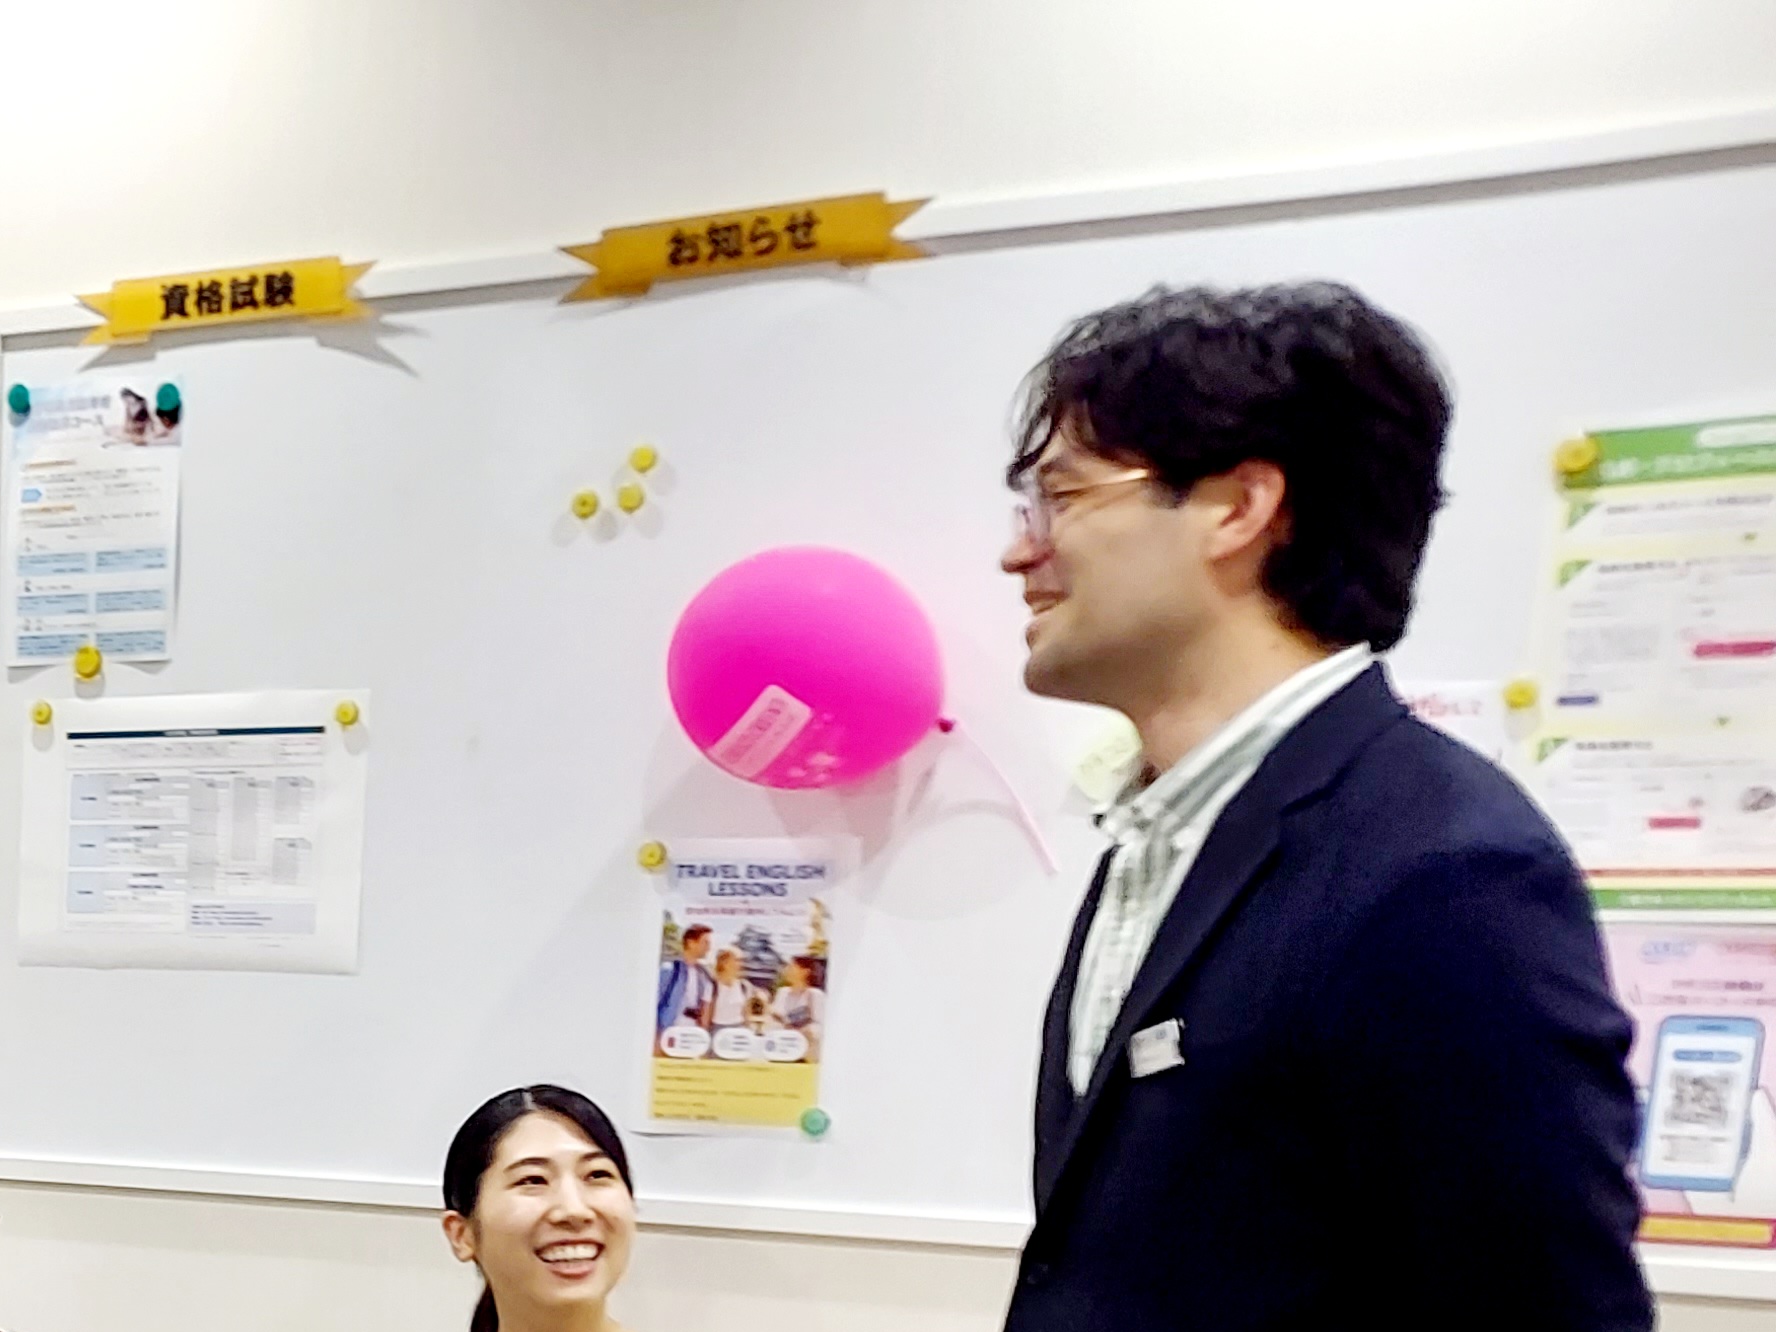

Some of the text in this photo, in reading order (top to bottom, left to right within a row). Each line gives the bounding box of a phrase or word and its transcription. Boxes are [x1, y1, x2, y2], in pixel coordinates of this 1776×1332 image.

[667, 209, 821, 266] お知らせ
[160, 270, 296, 321] 資格試験
[676, 863, 824, 879] TRAVEL ENGLISH
[708, 881, 788, 897] LESSONS
